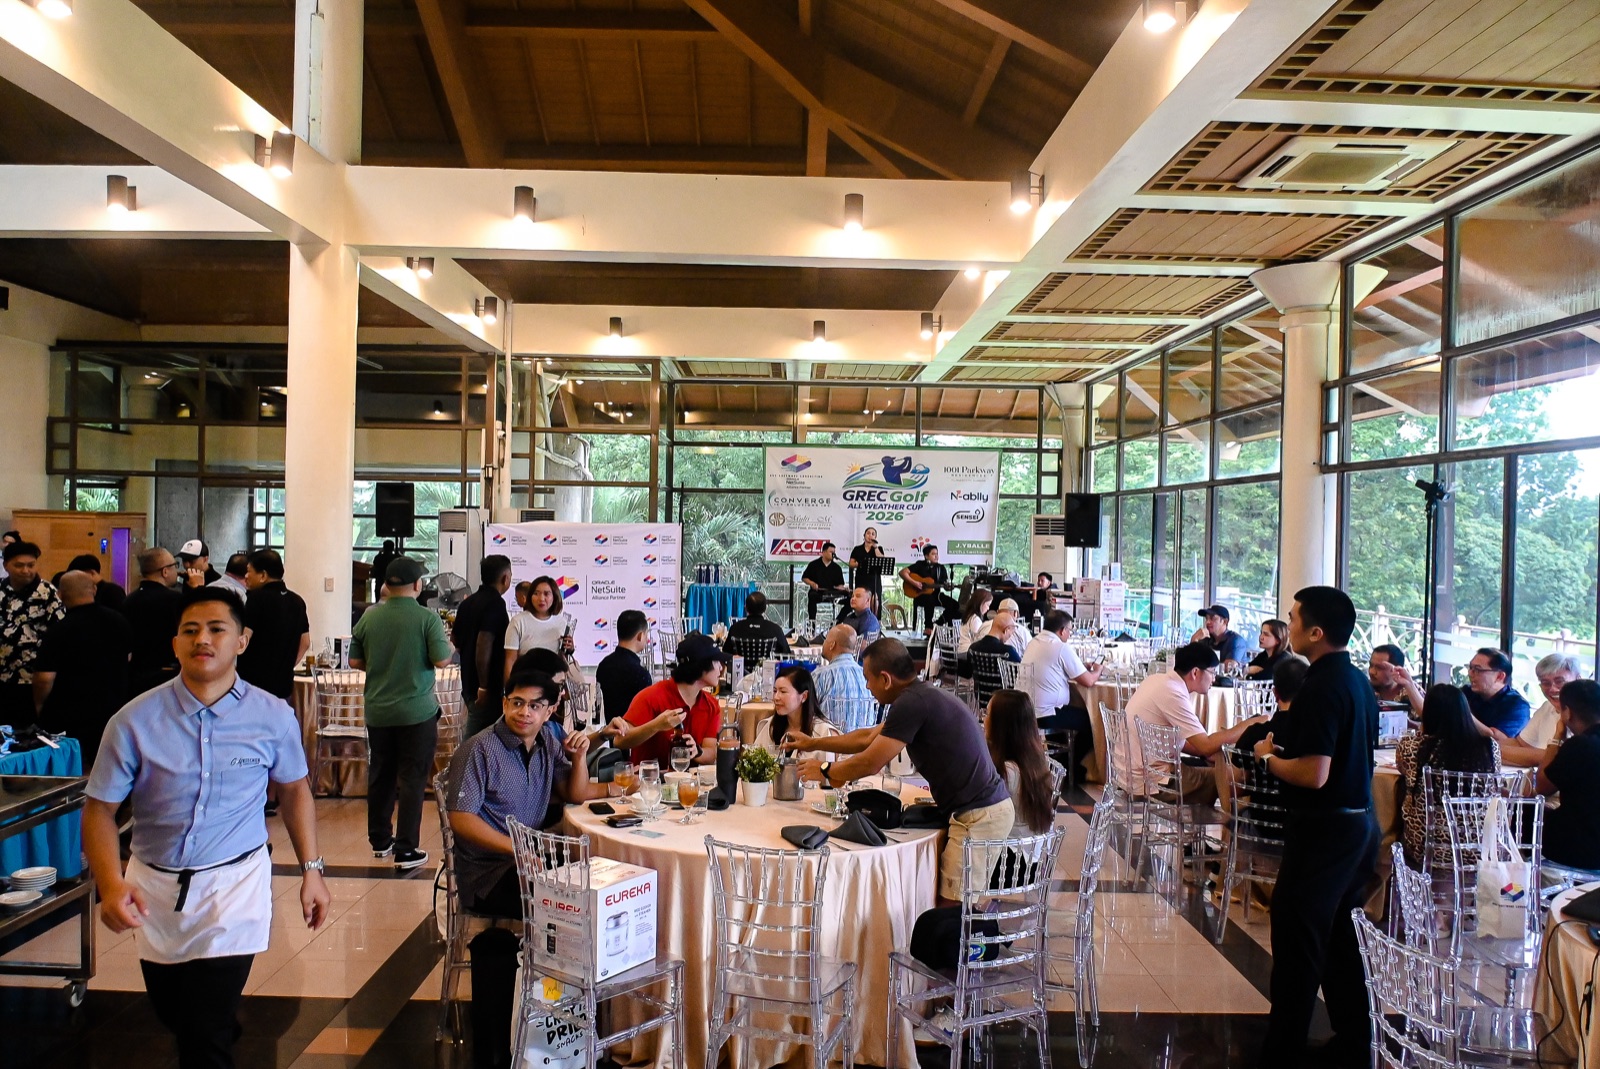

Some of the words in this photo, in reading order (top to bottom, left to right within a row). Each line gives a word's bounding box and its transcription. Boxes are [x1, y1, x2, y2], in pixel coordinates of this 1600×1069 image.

[962, 466, 994, 474] Parkway
[842, 490, 888, 502] GREC
[890, 490, 929, 502] Golf
[866, 511, 904, 521] 2026
[605, 882, 651, 906] EUREKA
[556, 1031, 584, 1050] SNACKS
